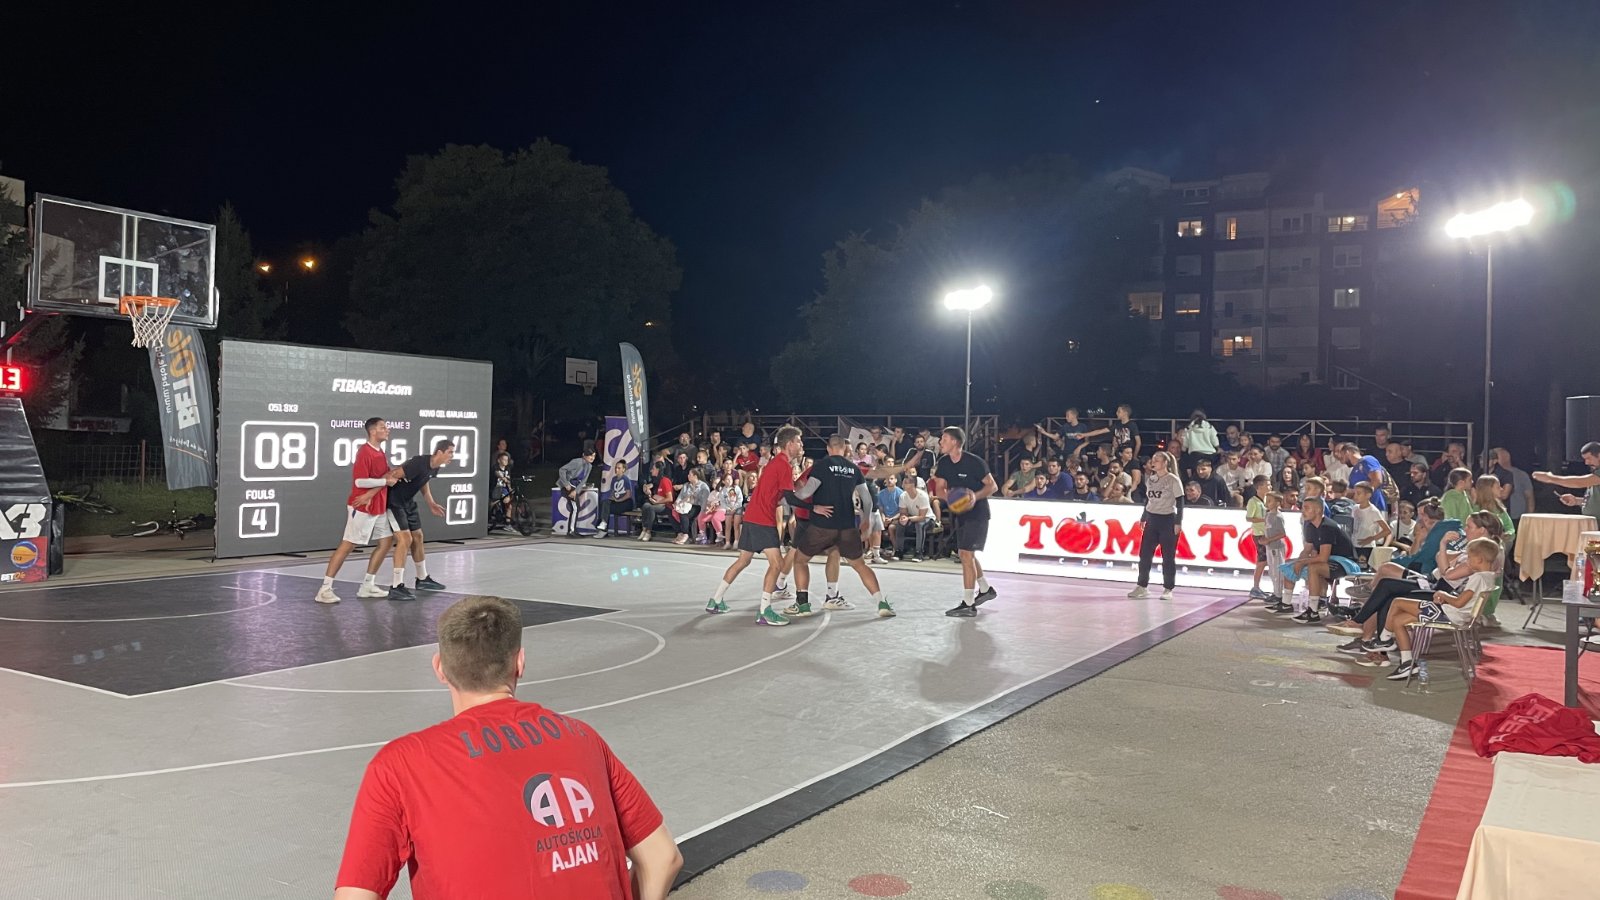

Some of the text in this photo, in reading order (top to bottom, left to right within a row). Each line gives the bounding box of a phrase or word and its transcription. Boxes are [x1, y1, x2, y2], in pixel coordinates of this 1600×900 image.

[332, 379, 413, 396] FIBA3x3.com
[330, 420, 366, 430] QUARTER-
[385, 421, 404, 429] GAME
[255, 432, 306, 469] 08
[245, 489, 275, 500] FOULS
[451, 484, 472, 493] FOULS
[455, 499, 467, 519] 4
[251, 508, 267, 531] 4
[536, 826, 603, 853] AUTOŠKOLA
[552, 841, 599, 873] AJAN
